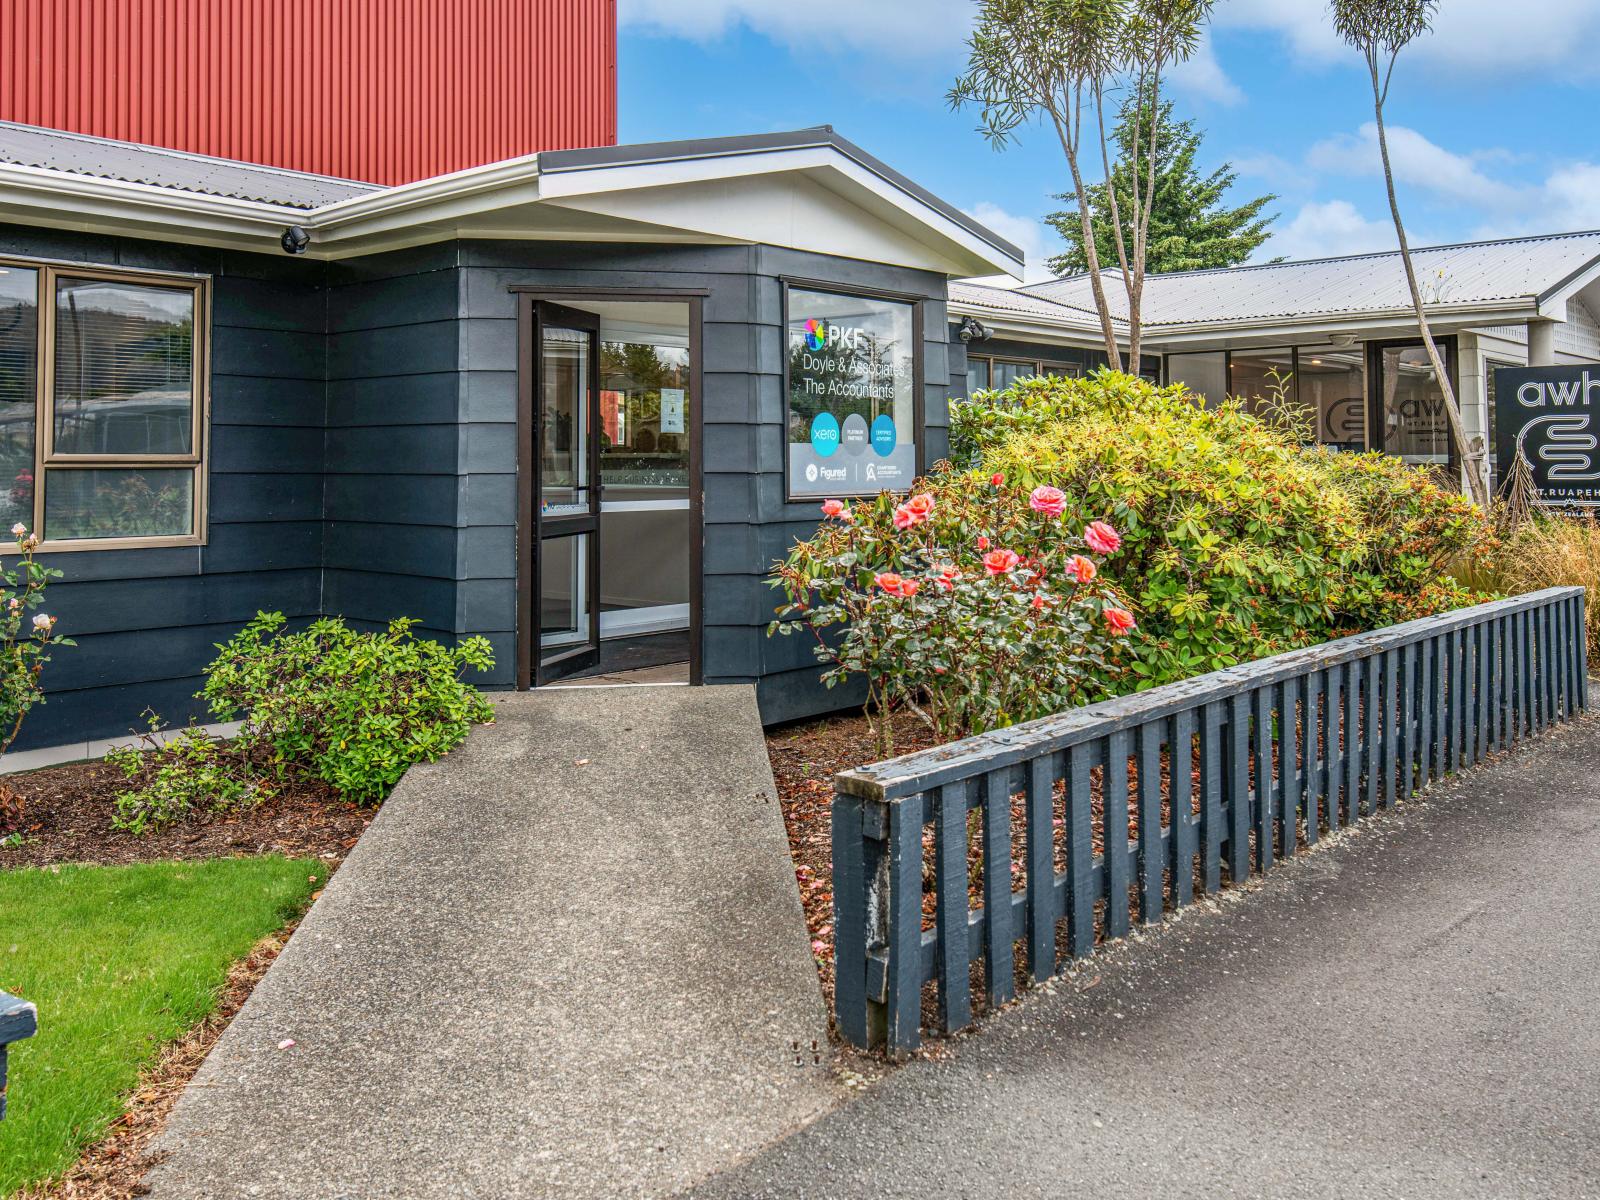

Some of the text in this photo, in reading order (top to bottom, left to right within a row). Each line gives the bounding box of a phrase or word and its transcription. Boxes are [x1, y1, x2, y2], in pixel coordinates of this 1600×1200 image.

[828, 325, 865, 349] PKF
[803, 353, 905, 377] Doyle & Associates
[803, 377, 895, 399] The Accountants
[1400, 399, 1446, 418] aw
[814, 428, 837, 441] xero
[820, 466, 847, 480] Figured
